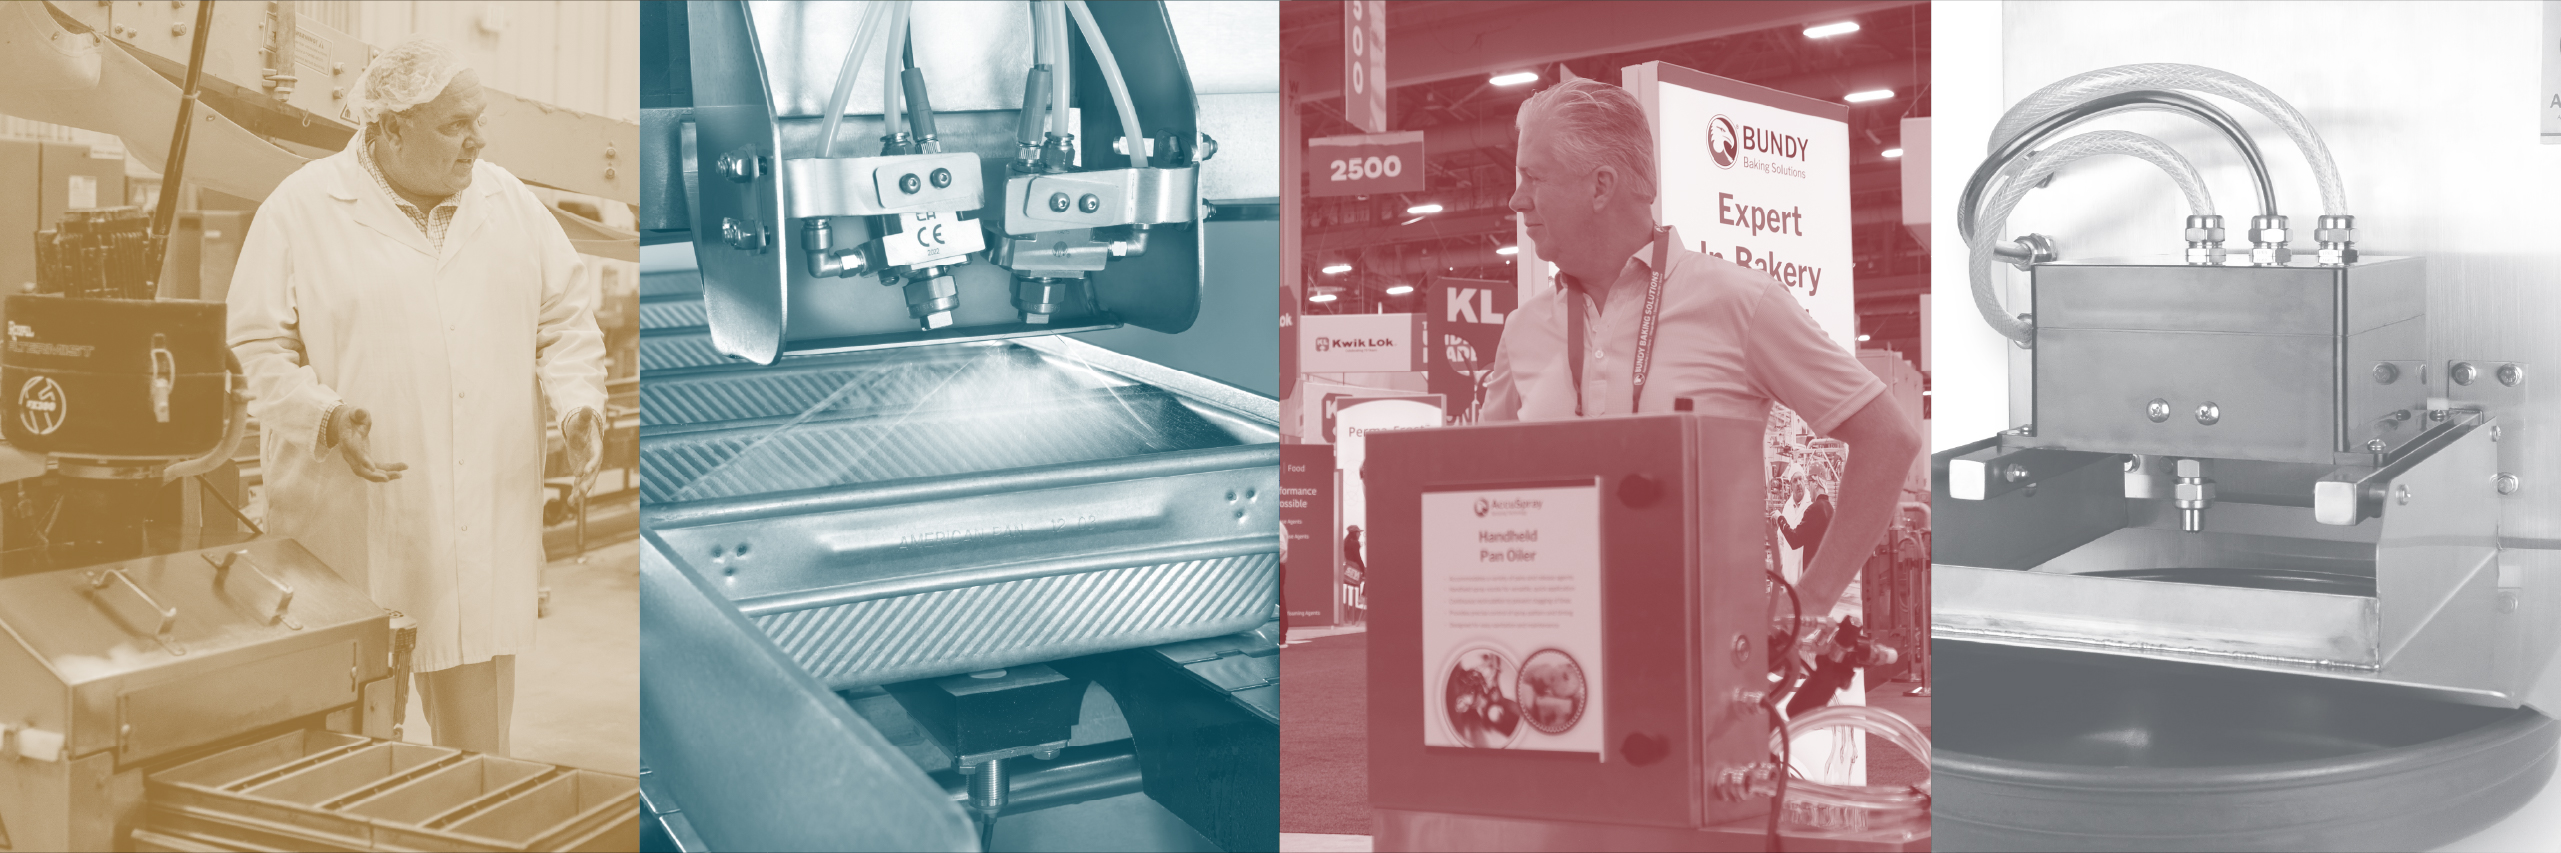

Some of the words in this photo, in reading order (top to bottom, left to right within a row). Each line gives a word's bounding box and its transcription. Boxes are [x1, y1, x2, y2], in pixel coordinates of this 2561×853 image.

[1743, 125, 1808, 162] BUNDY
[1330, 155, 1402, 182] 2500
[1743, 156, 1770, 173] Baking
[1771, 162, 1806, 179] Solutions
[1718, 191, 1803, 237] Expert
[917, 224, 945, 247] CE
[1645, 271, 1660, 314] SOLUTIONS
[1447, 287, 1504, 325] KL
[1639, 315, 1651, 346] BAKING
[1332, 338, 1366, 348] Kwik
[1368, 337, 1394, 348] Lok
[1635, 347, 1646, 373] BUNDY
[1287, 464, 1306, 473] Food
[1491, 499, 1543, 510] AccuSpray
[899, 527, 984, 549] AMERICAN
[1478, 529, 1538, 543] Handheld
[1479, 549, 1504, 562] Pan
[1506, 549, 1537, 562] Oiler
